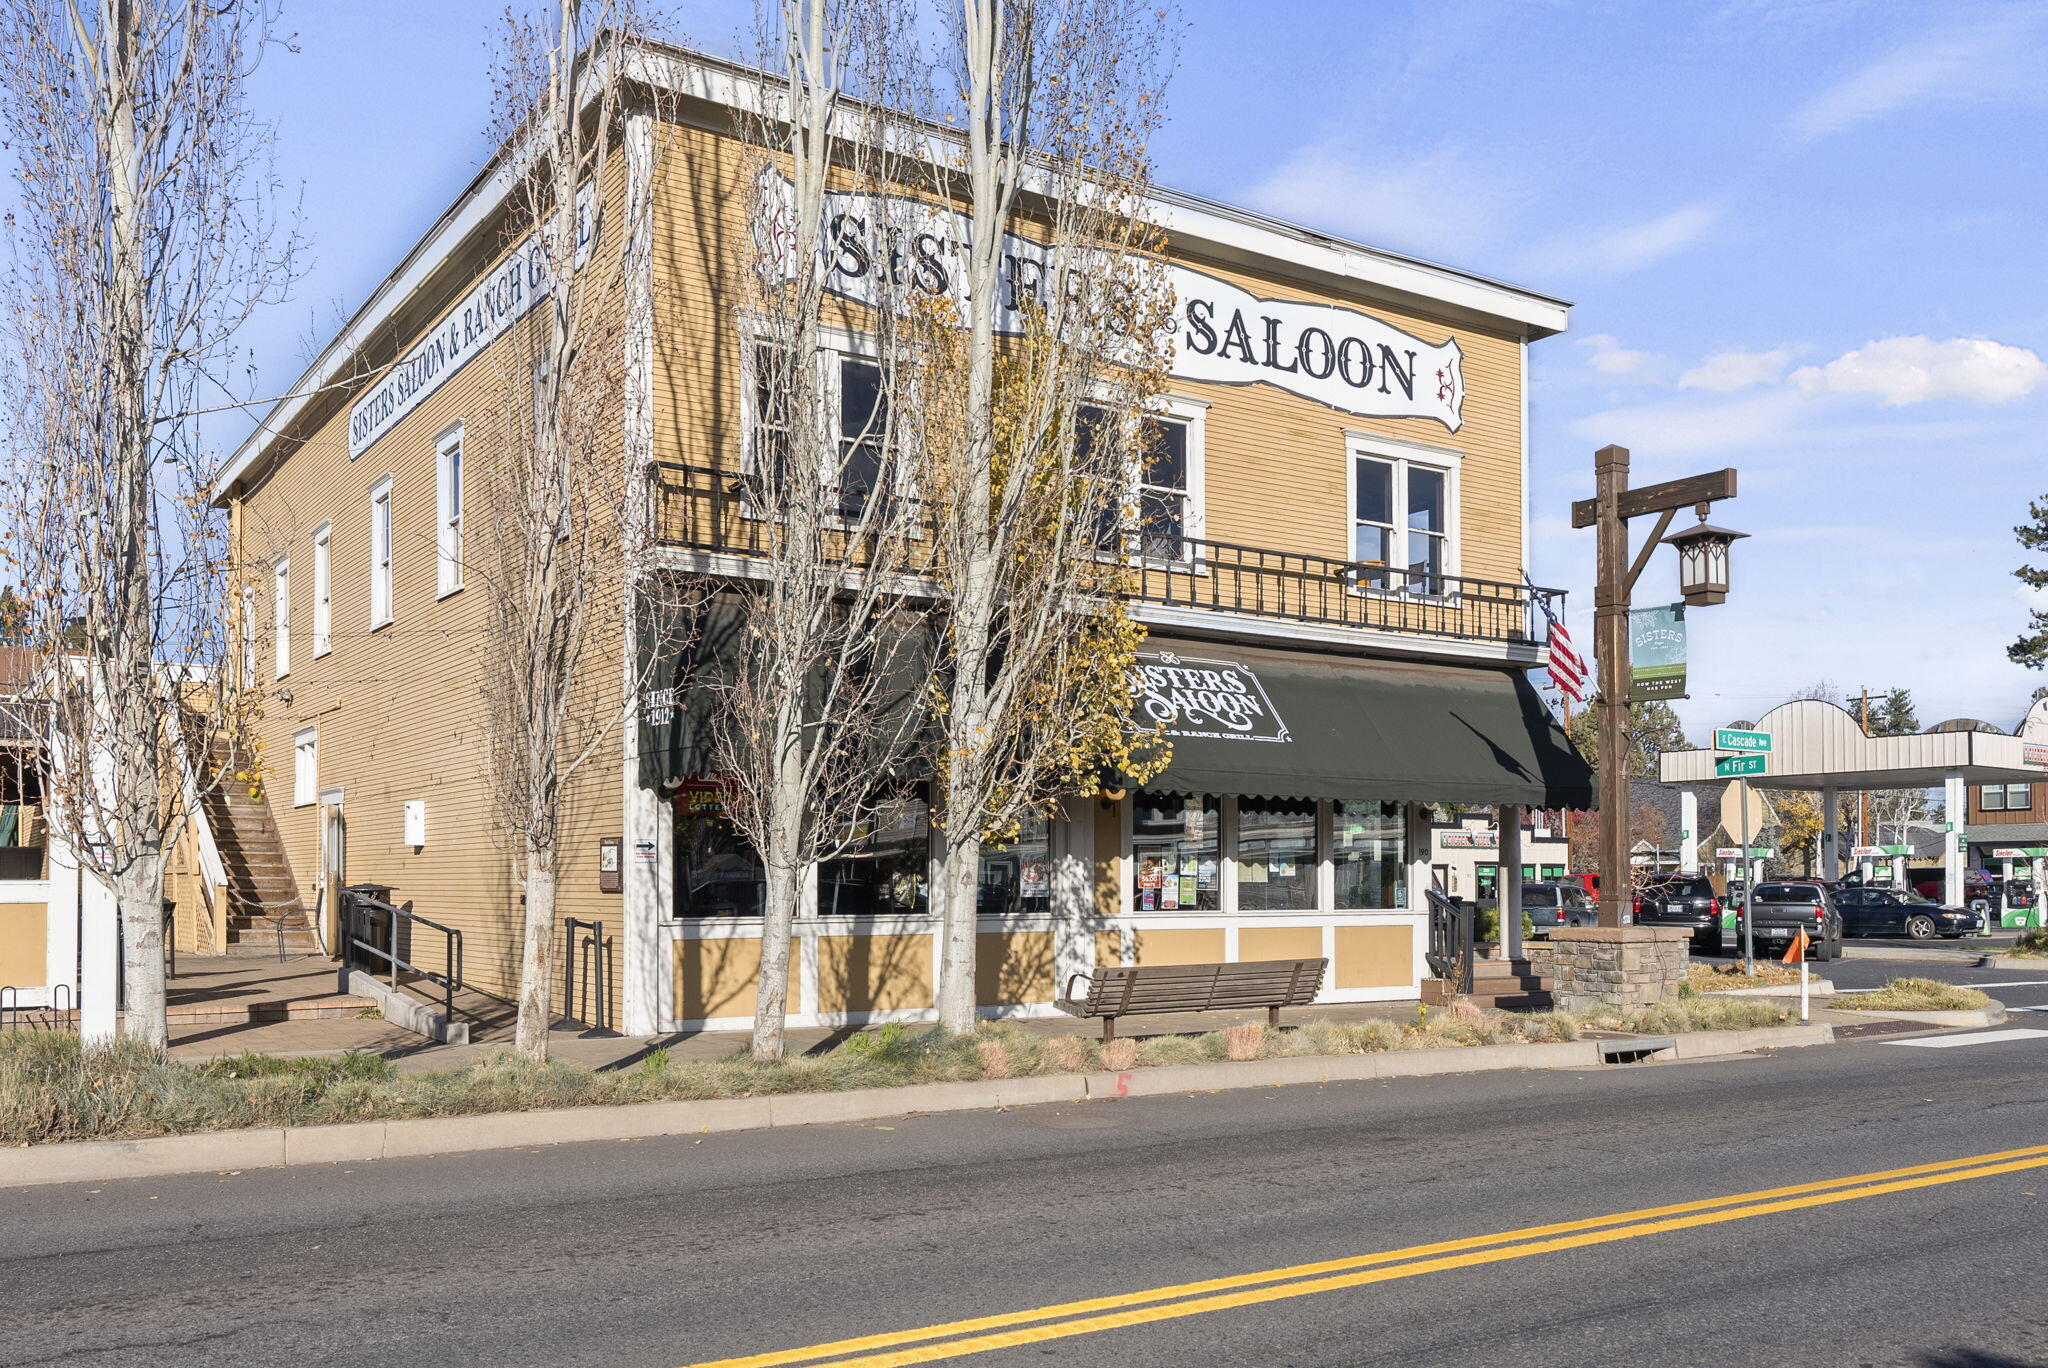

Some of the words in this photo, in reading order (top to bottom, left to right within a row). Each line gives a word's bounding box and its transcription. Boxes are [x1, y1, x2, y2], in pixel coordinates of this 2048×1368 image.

[828, 212, 1143, 338] SISE
[1186, 298, 1418, 401] SALOON
[352, 382, 395, 446] SISTERS
[397, 333, 447, 407] SALOON
[449, 318, 461, 360] &
[463, 260, 523, 349] RANCH
[1635, 629, 1684, 647] SISTERS
[651, 707, 670, 726] 1912
[1144, 684, 1265, 732] SALOON
[1181, 730, 1222, 738] RANCH
[1222, 733, 1255, 741] GRILL
[1722, 734, 1726, 744] E
[1728, 733, 1757, 748] Cascade
[1759, 738, 1768, 747] Ave
[1724, 763, 1730, 771] N
[1732, 760, 1746, 772] Fir
[1748, 760, 1757, 769] ST
[1418, 848, 1428, 856] 190
